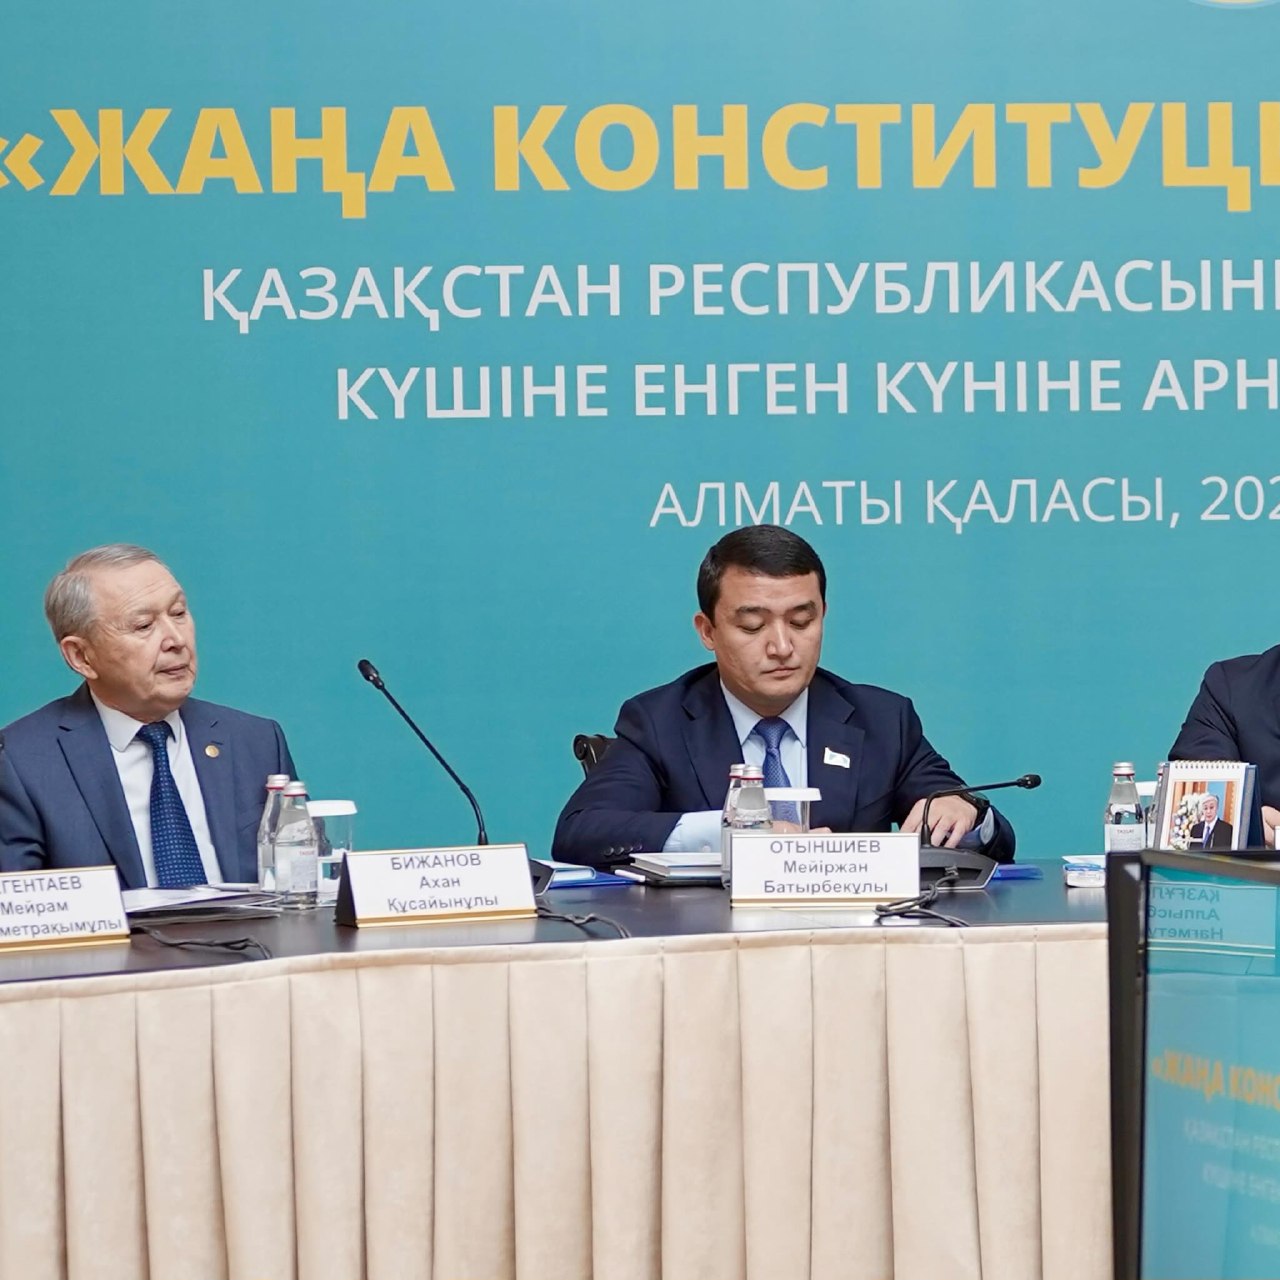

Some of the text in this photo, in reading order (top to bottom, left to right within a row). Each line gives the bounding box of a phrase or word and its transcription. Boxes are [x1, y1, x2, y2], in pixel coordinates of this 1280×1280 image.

[202, 264, 621, 334] ҚАЗАҚСТАН
[336, 364, 608, 420] КҮШІНЕ
[634, 362, 849, 416] ЕНГЕН
[876, 359, 1122, 414] КҮНІНЕ
[649, 480, 903, 527] АЛМАТЫ
[925, 477, 1180, 534] ҚАЛАСЫ,
[769, 840, 881, 854] ОТЫНШИЕВ
[390, 852, 482, 871] БИЖАНОВ
[783, 859, 869, 876] Мейіржан
[0, 875, 82, 895] ГЕНТАЕВ
[419, 875, 461, 889] Ахан
[764, 880, 889, 895] Батырбекұлы
[0, 899, 69, 917] Мейрам
[387, 895, 499, 913] Құсайынұлы
